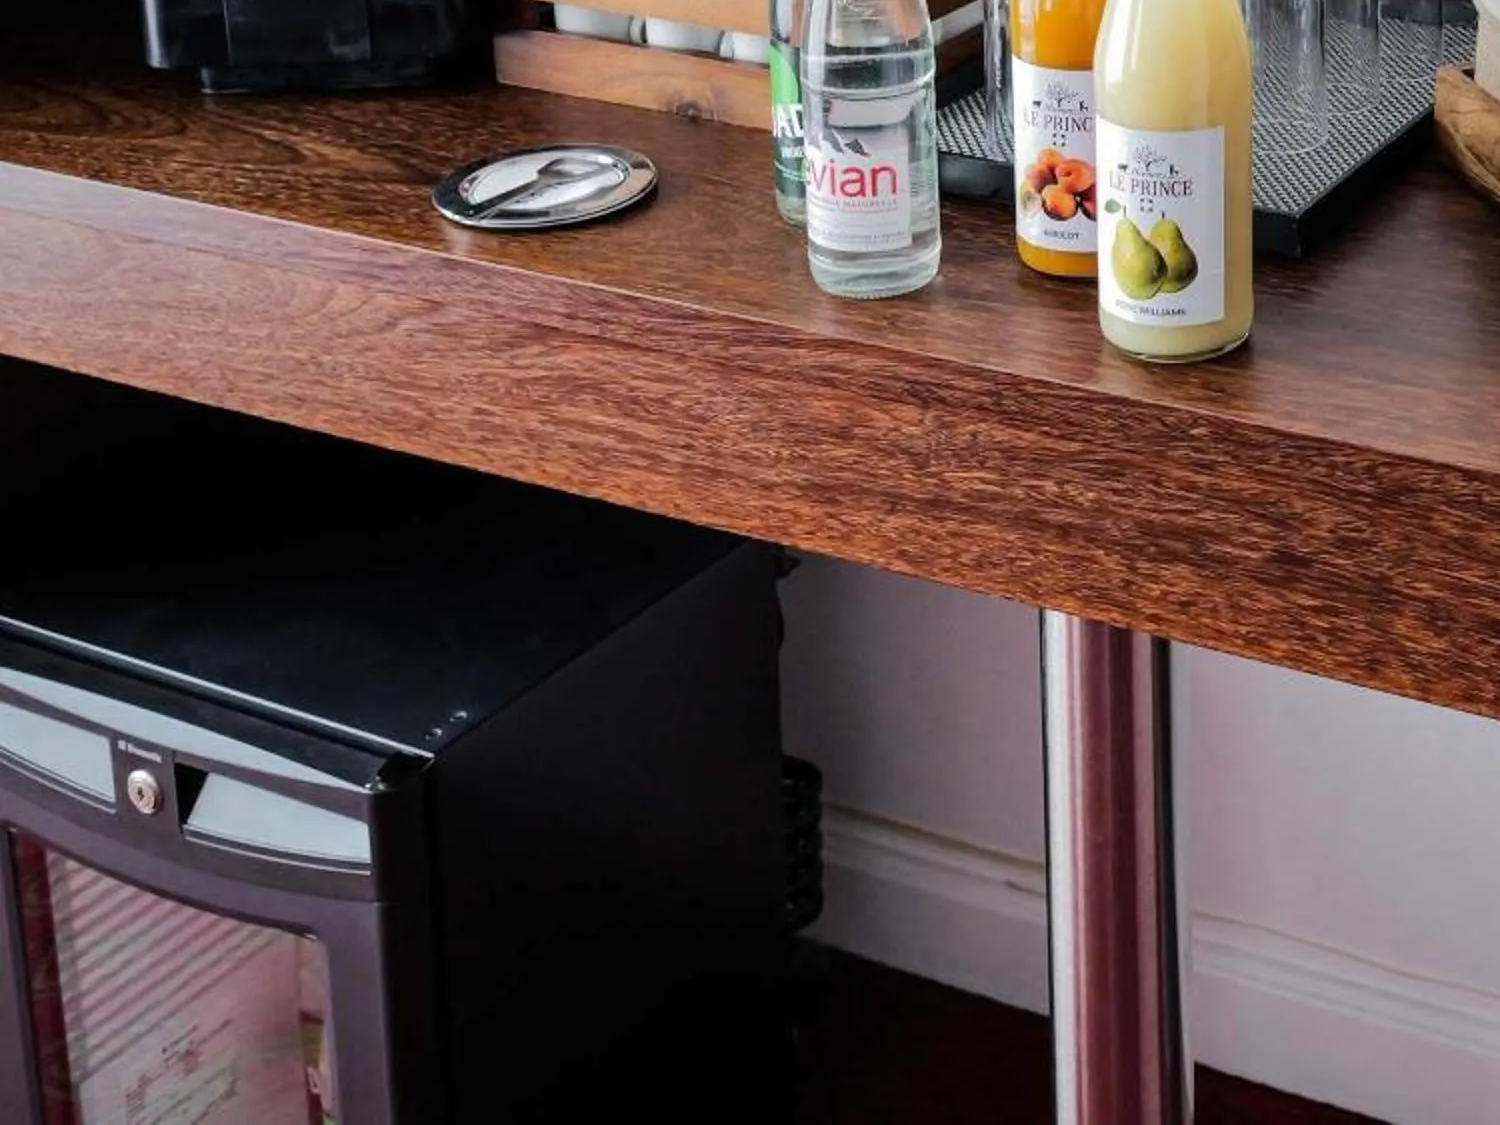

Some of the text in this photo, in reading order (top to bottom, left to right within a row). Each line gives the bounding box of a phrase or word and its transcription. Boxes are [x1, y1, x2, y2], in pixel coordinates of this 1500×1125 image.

[1043, 115, 1093, 133] PRINC
[1109, 171, 1125, 191] LE
[1131, 178, 1194, 197] PRINCE
